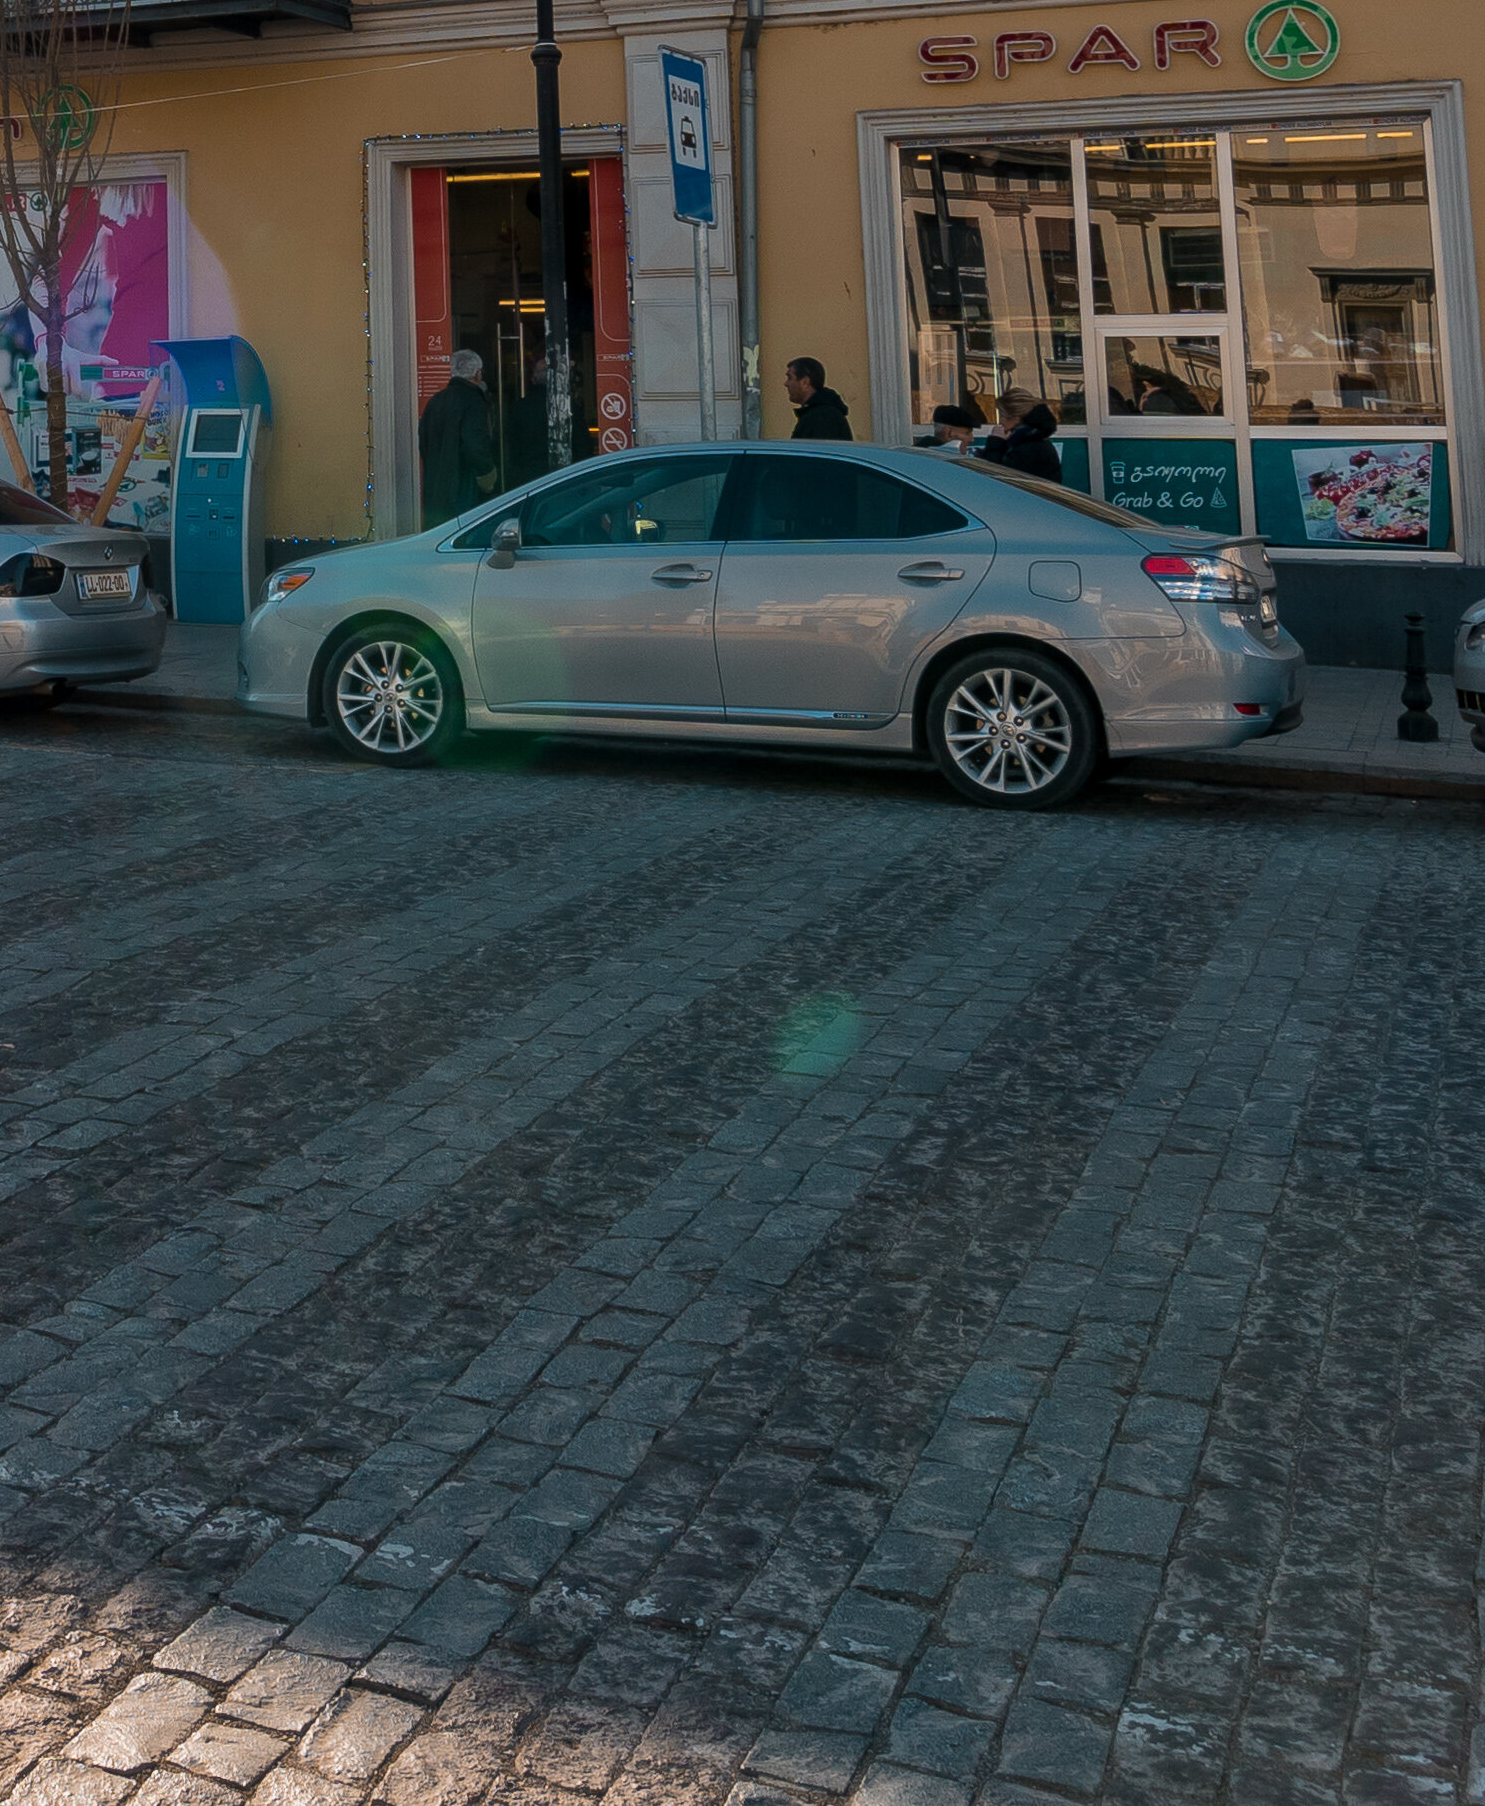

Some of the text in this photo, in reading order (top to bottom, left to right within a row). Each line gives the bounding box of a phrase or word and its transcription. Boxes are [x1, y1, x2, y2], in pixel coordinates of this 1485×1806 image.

[919, 19, 1223, 84] SPAR
[428, 335, 442, 346] 24
[112, 369, 146, 379] SPAR
[1113, 491, 1205, 508] Grab & Go
